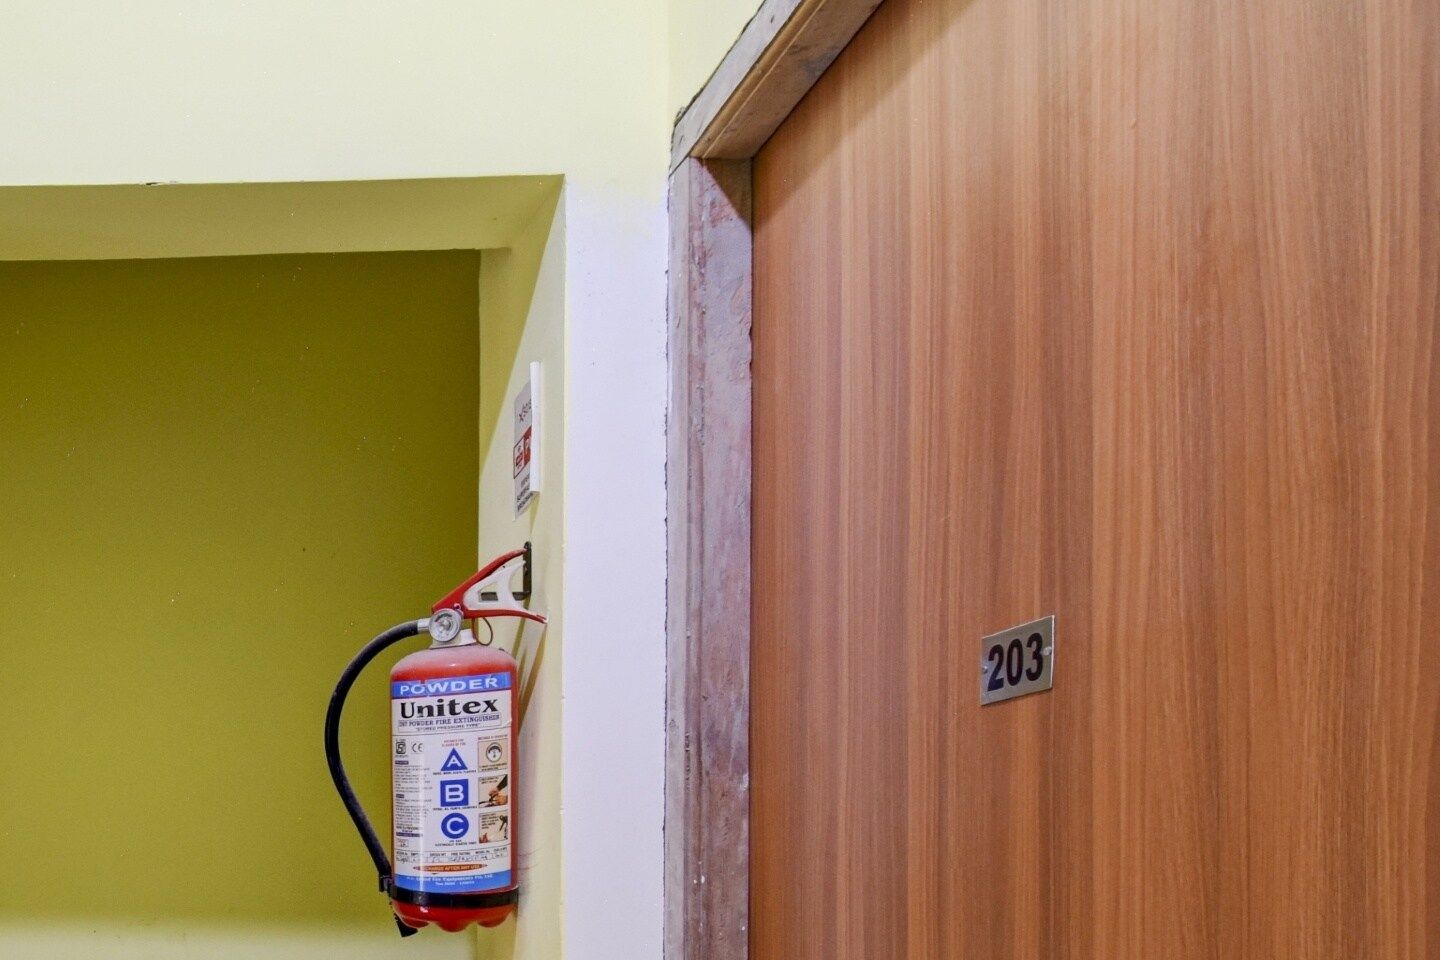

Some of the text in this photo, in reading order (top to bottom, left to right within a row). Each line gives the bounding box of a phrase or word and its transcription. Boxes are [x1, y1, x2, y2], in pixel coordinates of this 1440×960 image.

[987, 632, 1044, 692] 203
[400, 677, 499, 695] POWDER
[401, 699, 498, 719] Unitex
[446, 755, 462, 768] A
[445, 784, 465, 802] B
[446, 817, 464, 834] C
